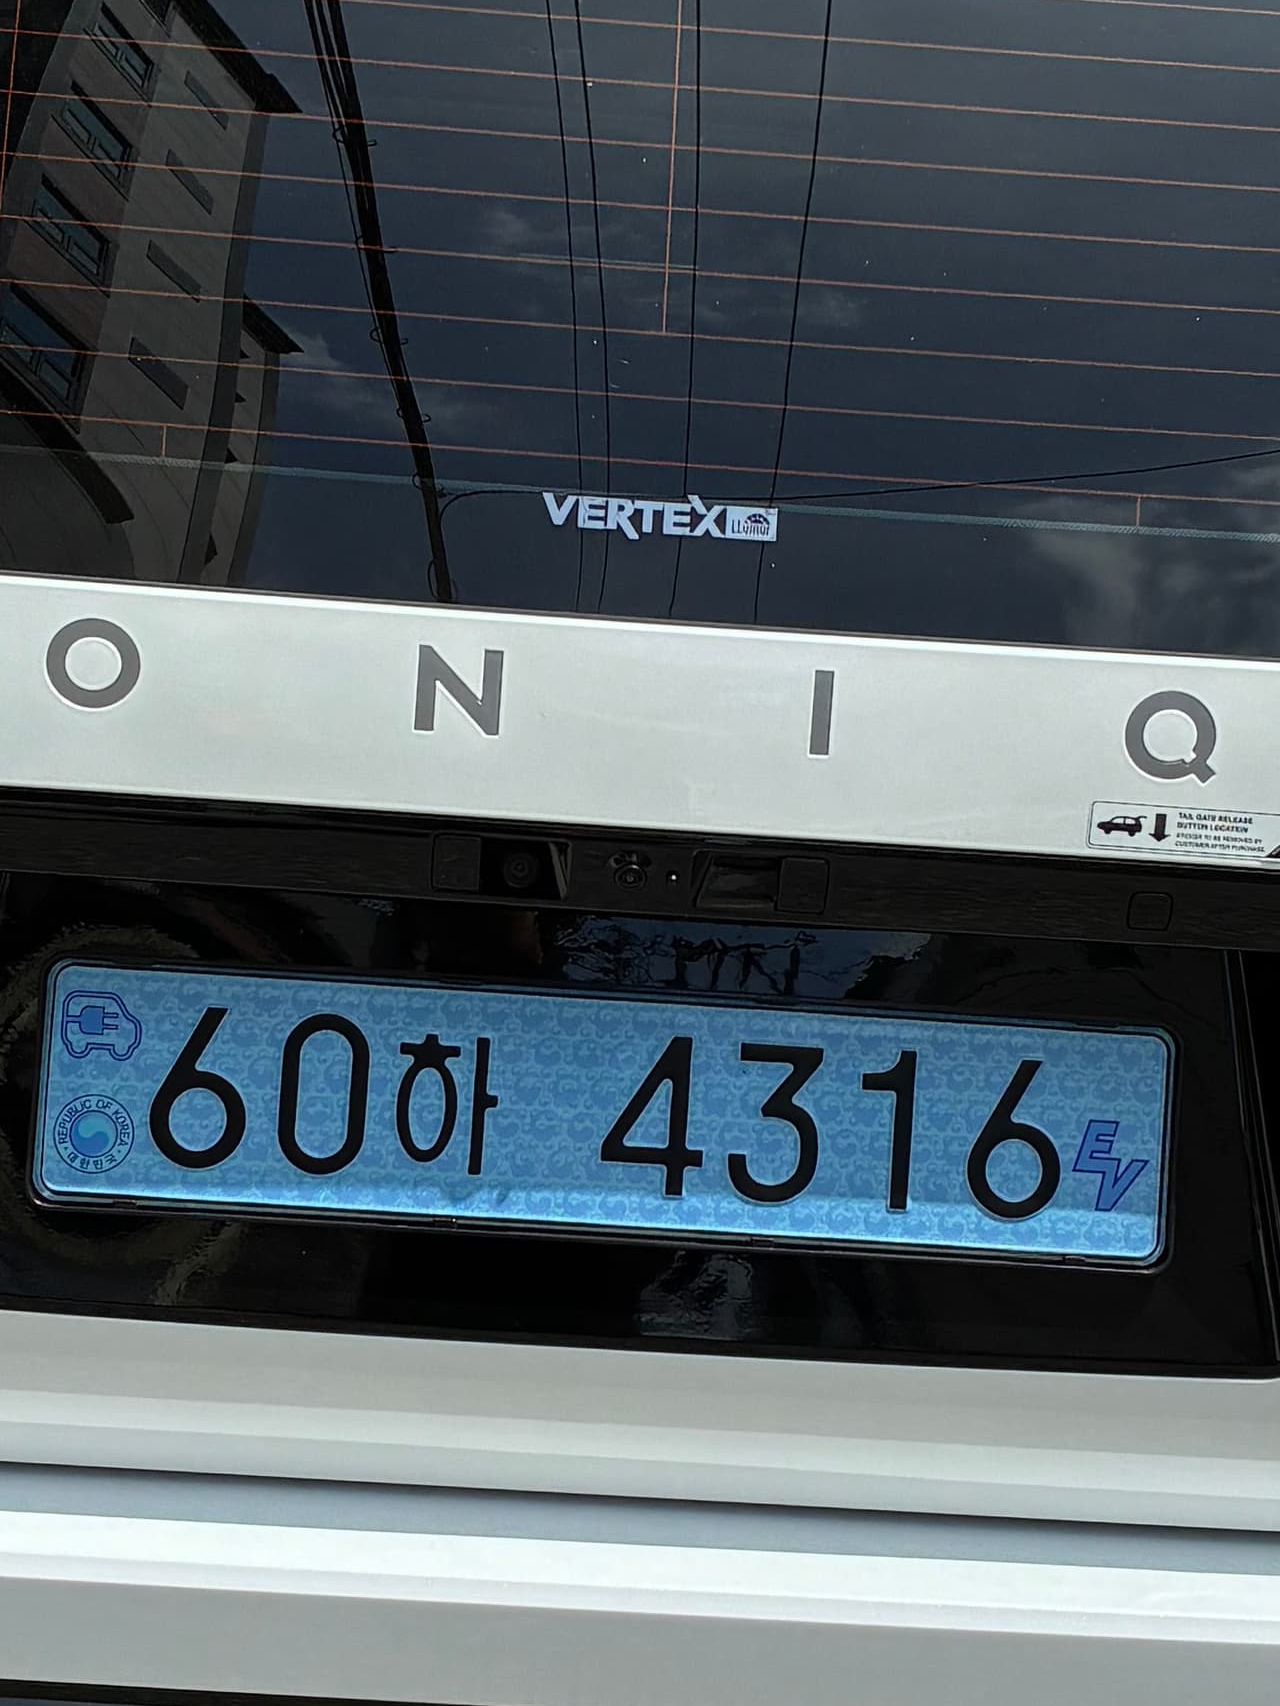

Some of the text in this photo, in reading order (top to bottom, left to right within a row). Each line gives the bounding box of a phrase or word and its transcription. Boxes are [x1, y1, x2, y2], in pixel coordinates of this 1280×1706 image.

[542, 492, 726, 541] VERTEX
[1178, 811, 1195, 821] TAIL
[1217, 814, 1254, 825] RELEASE
[1209, 823, 1249, 834] LOCATION
[58, 1098, 131, 1147] REPUBLIC OF KOREA
[148, 1006, 1061, 1221] 60하 4316
[1072, 1119, 1150, 1213] EV
